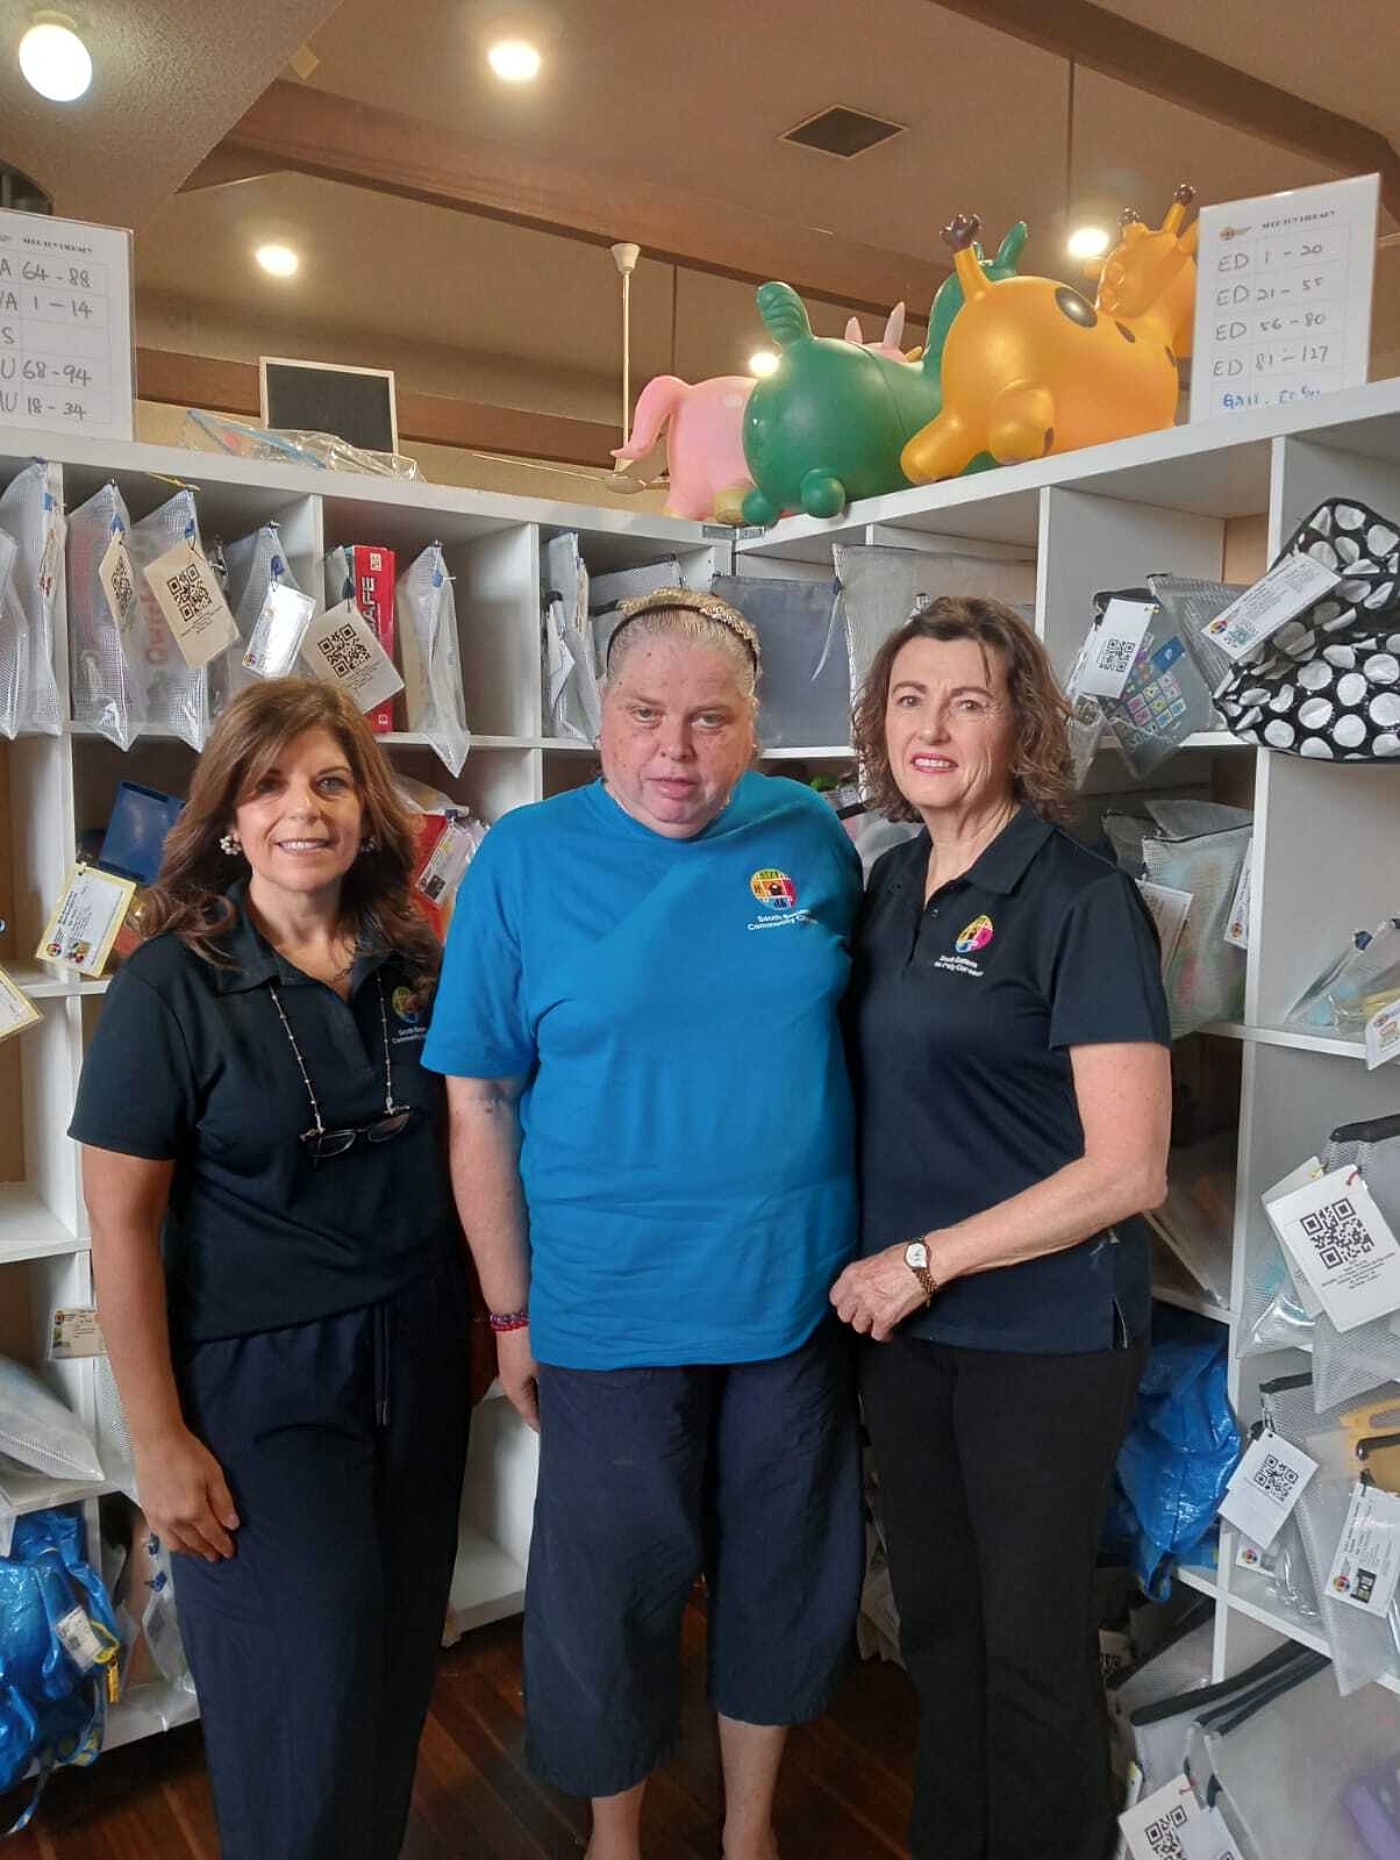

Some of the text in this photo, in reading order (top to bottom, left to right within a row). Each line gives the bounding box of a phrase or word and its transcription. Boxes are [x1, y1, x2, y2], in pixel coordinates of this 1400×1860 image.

[1218, 252, 1250, 273] ED
[21, 260, 49, 281] 64
[69, 267, 91, 288] 88
[1216, 284, 1250, 307] ED
[71, 300, 93, 319] 14
[1215, 321, 1247, 341] ED
[1212, 358, 1244, 377] ED
[1302, 346, 1330, 363] 127
[22, 360, 47, 380] 68
[63, 365, 92, 386] 94
[63, 402, 87, 421] 34
